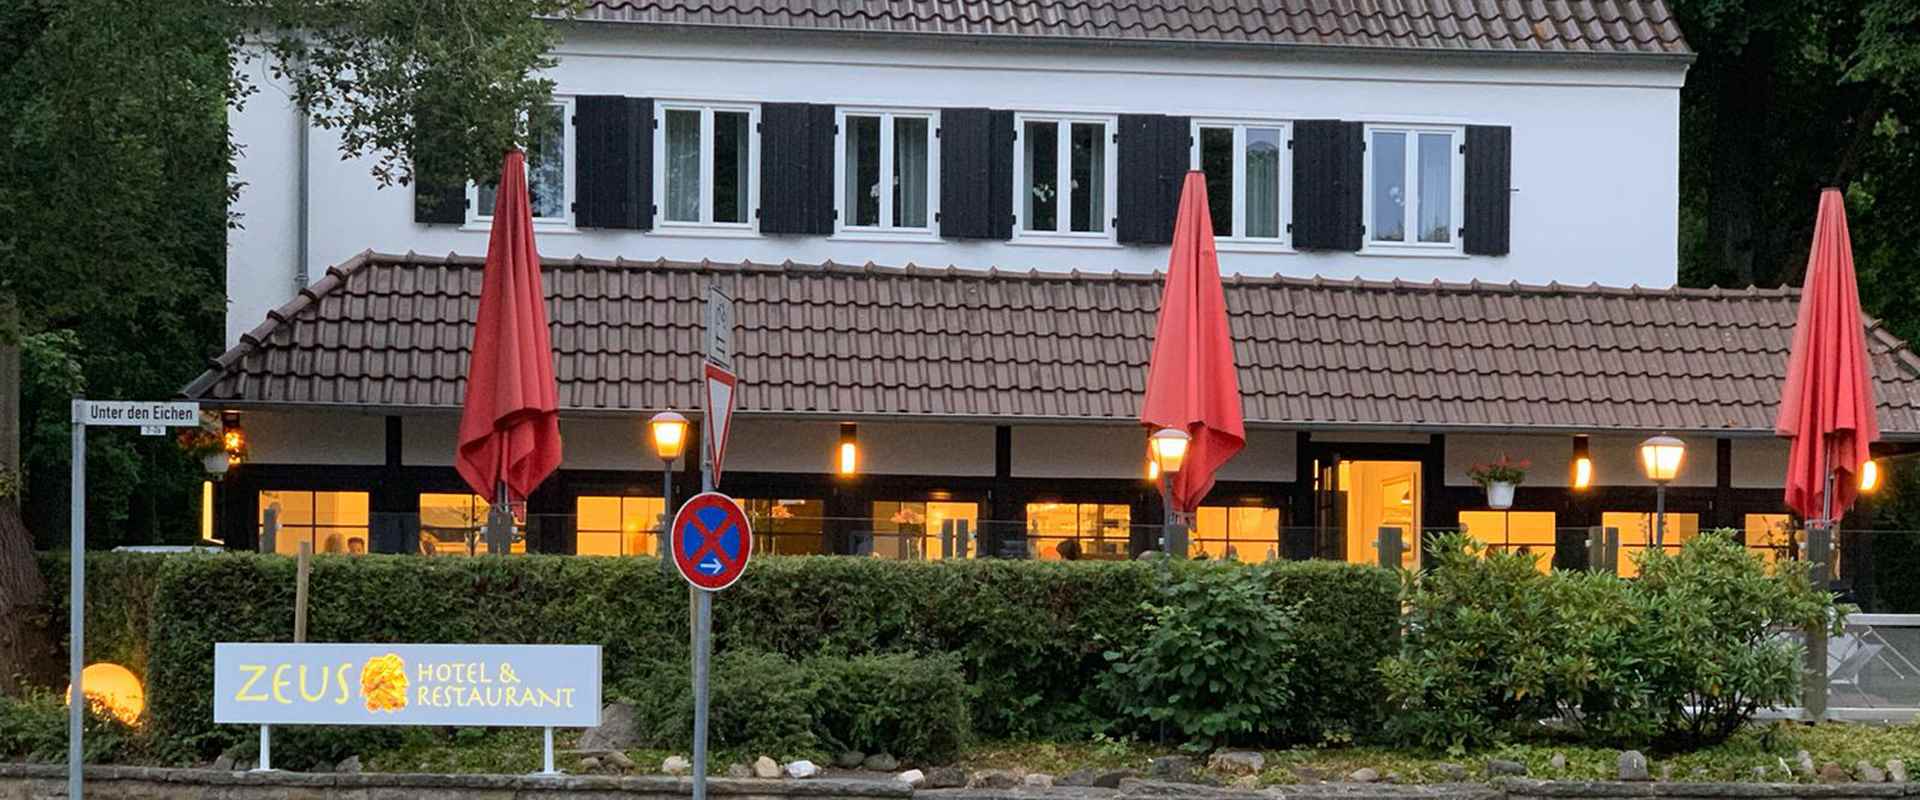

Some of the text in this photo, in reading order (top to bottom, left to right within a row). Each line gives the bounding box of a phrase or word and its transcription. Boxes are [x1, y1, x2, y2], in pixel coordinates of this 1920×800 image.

[90, 404, 193, 420] Unter den Eichen
[234, 662, 353, 705] ZEUS
[417, 661, 521, 684] HOTEL &
[417, 685, 576, 708] RESTAURANT
